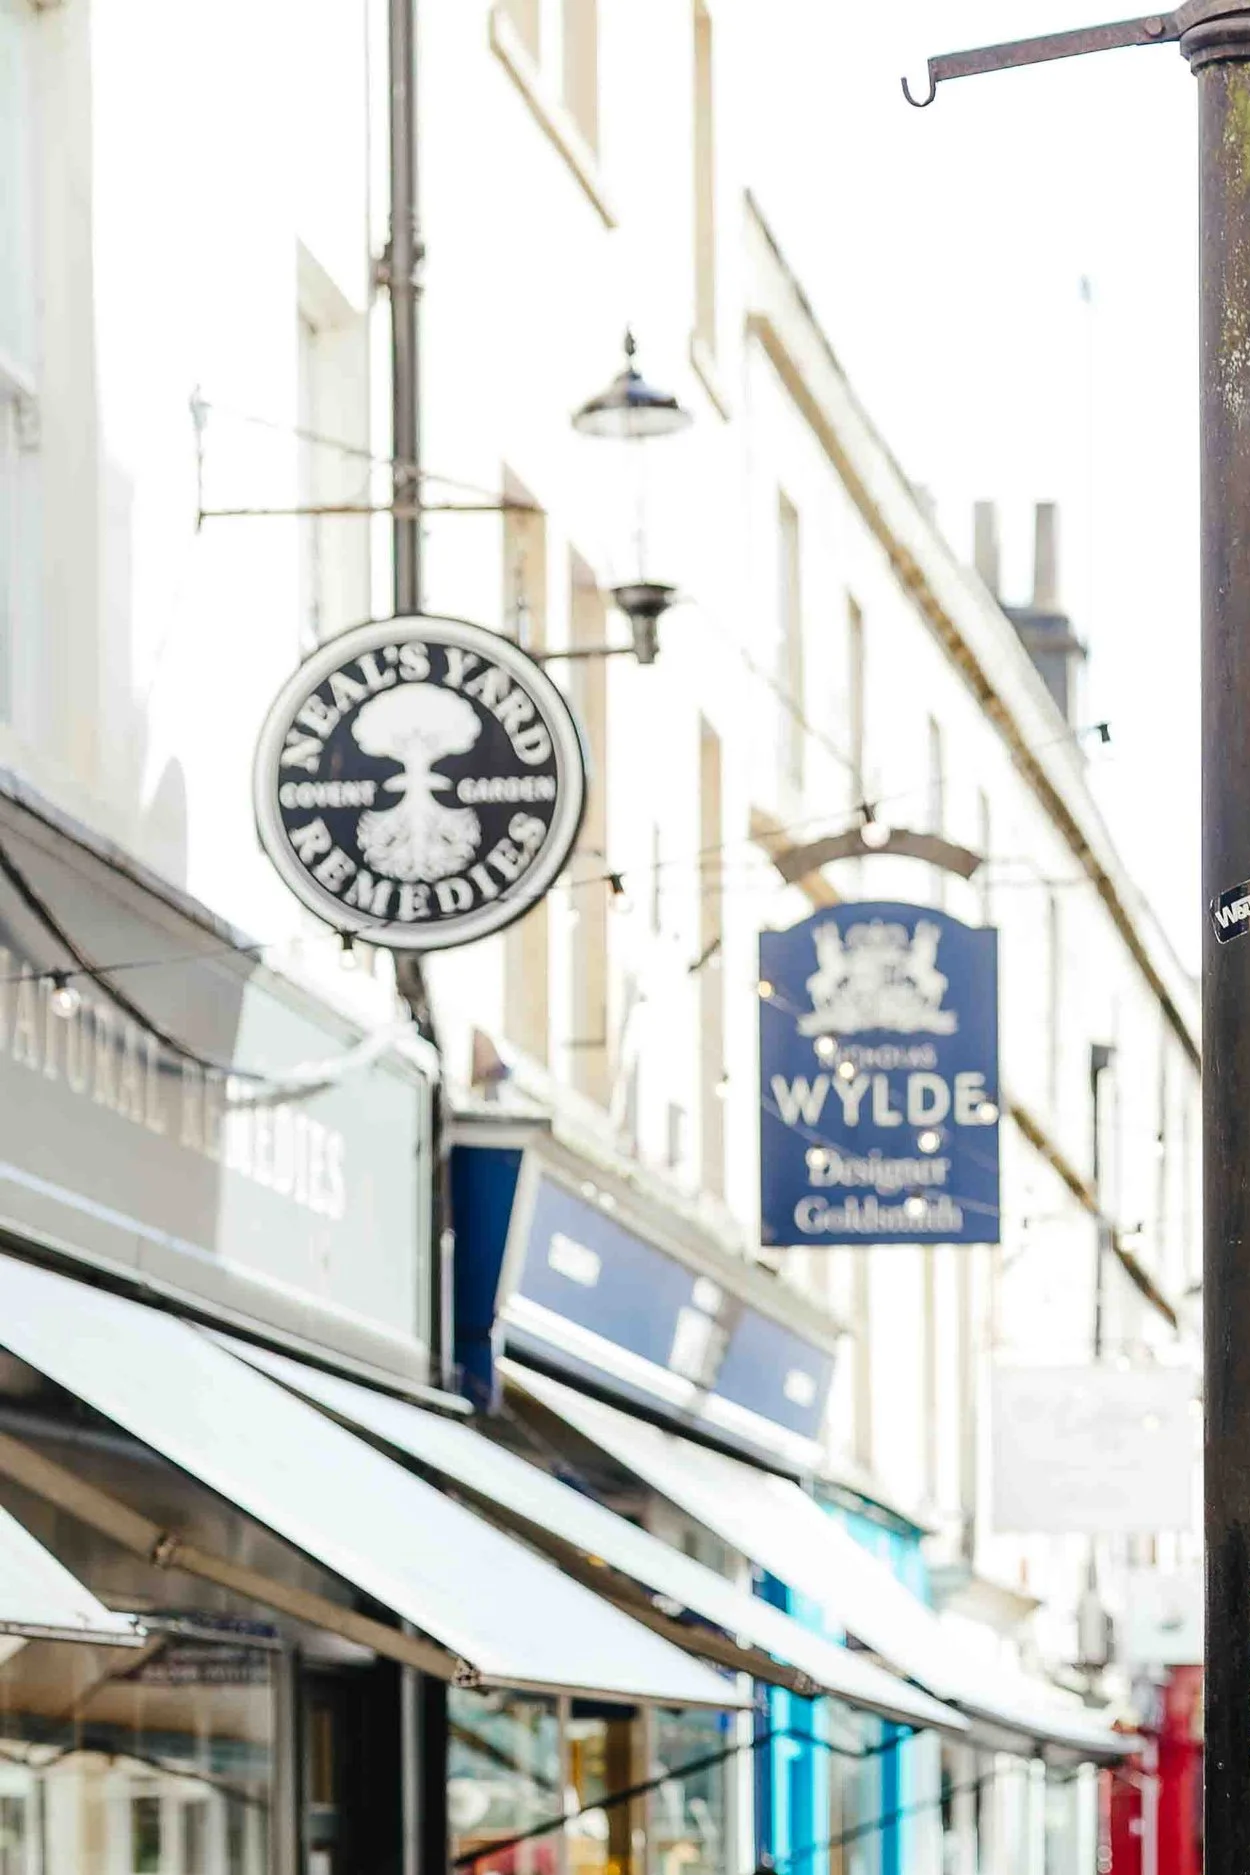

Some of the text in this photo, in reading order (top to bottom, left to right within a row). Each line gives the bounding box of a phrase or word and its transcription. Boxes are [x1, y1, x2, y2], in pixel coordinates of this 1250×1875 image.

[280, 640, 552, 774] NEAL'S YARD
[279, 776, 557, 809] COVENT GARDEN
[289, 812, 547, 922] REMEDIES
[771, 1071, 992, 1128] WYLDE
[808, 1149, 951, 1196] Designer
